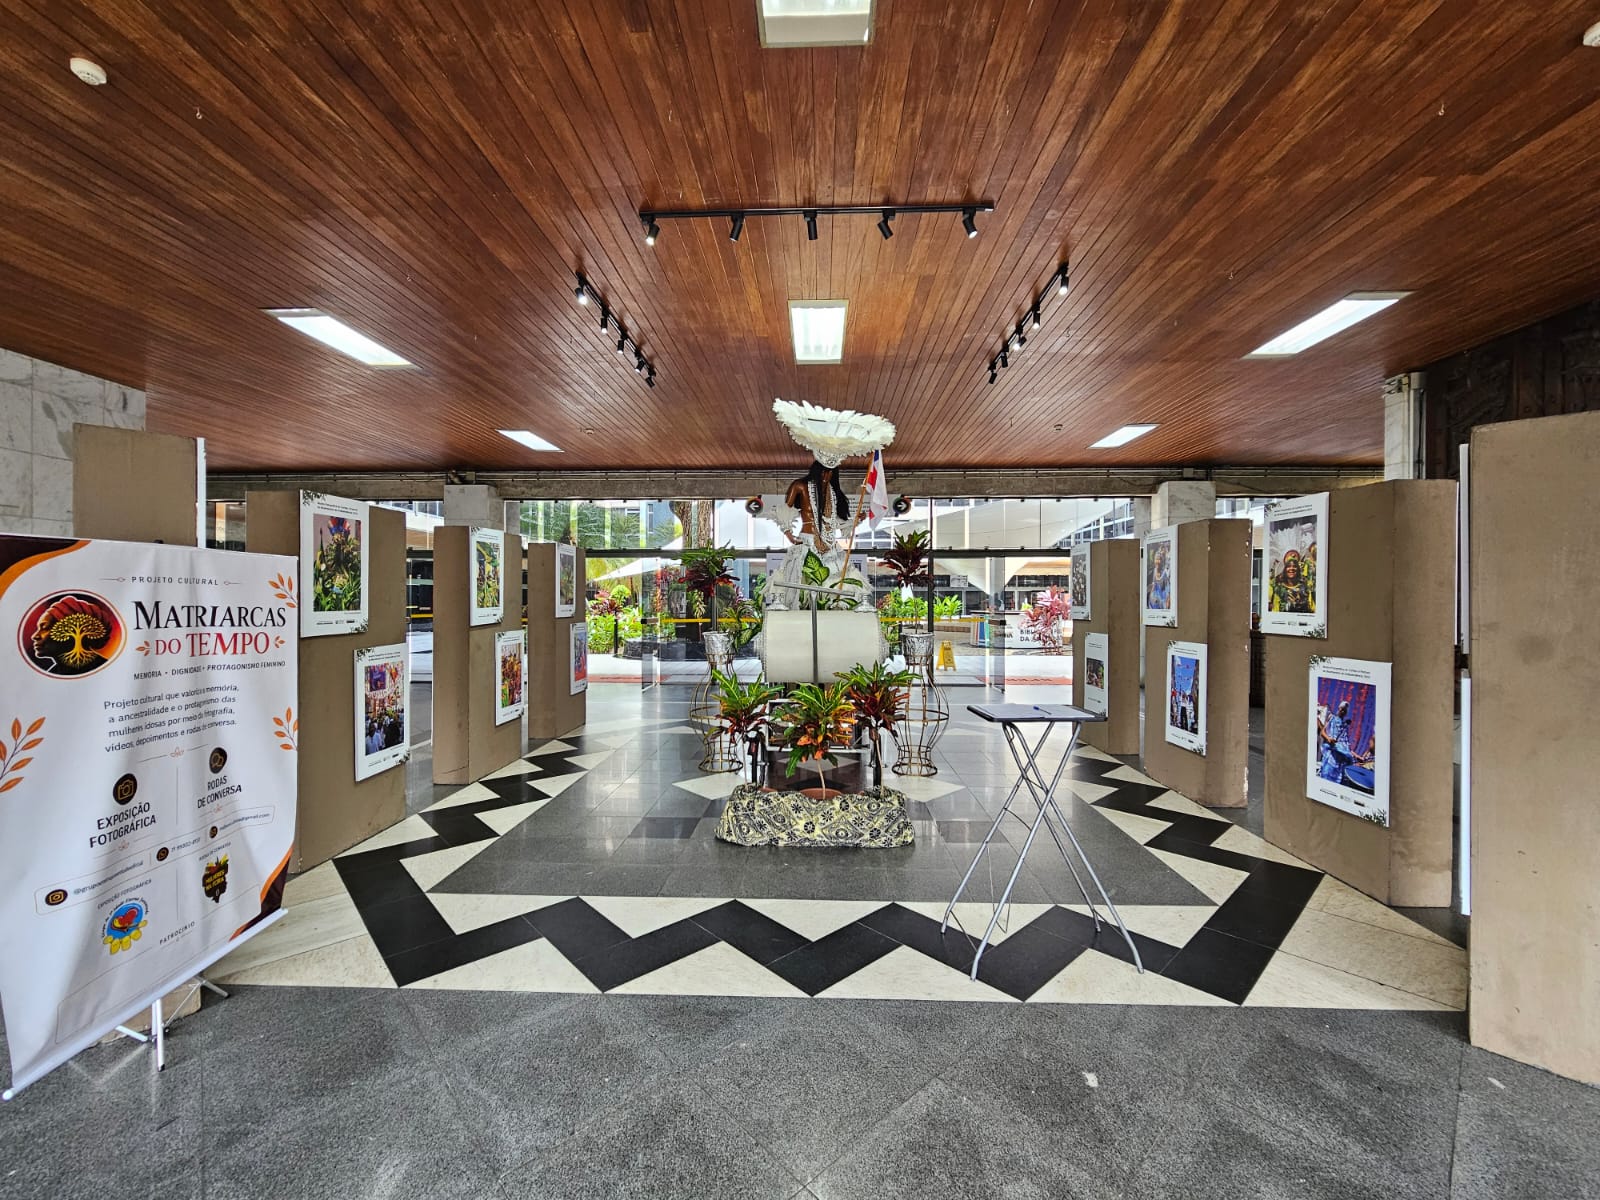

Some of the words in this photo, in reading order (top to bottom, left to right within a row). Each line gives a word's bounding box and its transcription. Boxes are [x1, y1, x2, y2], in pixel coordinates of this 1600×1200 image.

[132, 576, 173, 584] PROJETO
[178, 577, 219, 586] CULTURAL
[132, 600, 287, 630] MATRIARCAS
[155, 638, 182, 656] DO
[186, 631, 270, 657] TEMPO
[207, 662, 260, 671] PROTAGONISMO
[261, 661, 286, 669] FEMININO
[104, 697, 139, 710] Projeto
[140, 692, 164, 704] cultural
[165, 692, 180, 702] que
[108, 716, 115, 724] a
[118, 705, 169, 722] ancestralidade
[108, 725, 144, 738] mulheres
[145, 720, 166, 730] idosas
[167, 718, 181, 727] por
[182, 715, 198, 723] meio
[136, 730, 179, 747] depoimentos
[187, 725, 202, 735] rodas
[207, 775, 228, 791] RODAS
[197, 797, 206, 809] DE
[206, 784, 242, 805] CONVERSA
[97, 802, 151, 831] EXPOSIÇÃO
[89, 814, 157, 848] FOTOGRÁFICA
